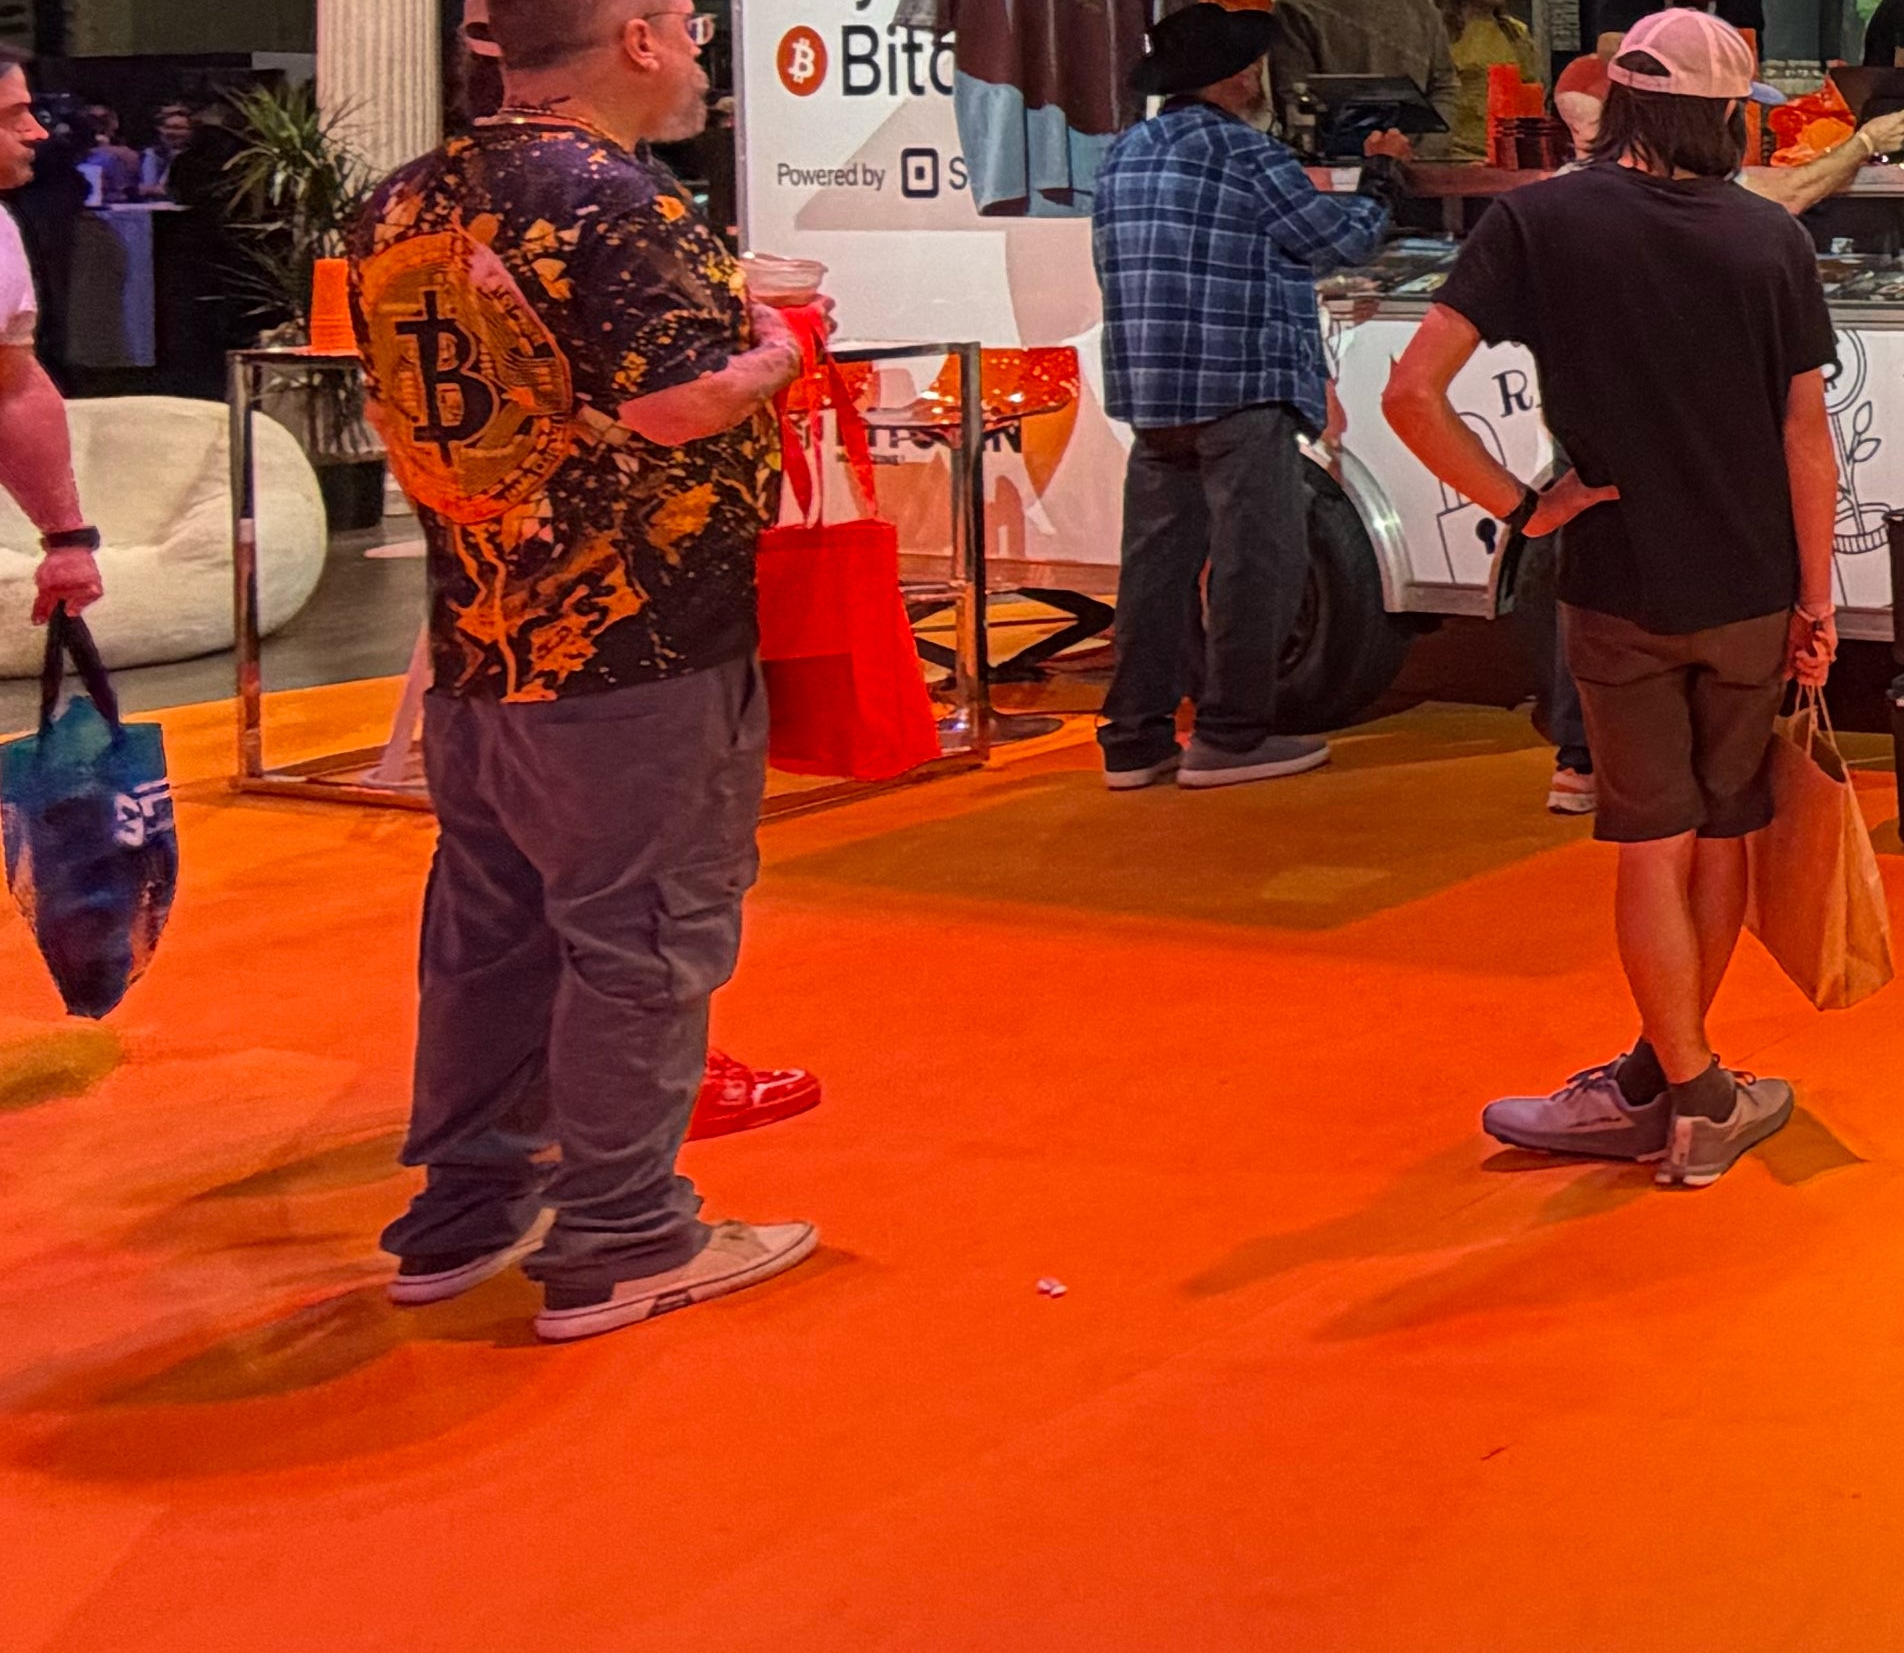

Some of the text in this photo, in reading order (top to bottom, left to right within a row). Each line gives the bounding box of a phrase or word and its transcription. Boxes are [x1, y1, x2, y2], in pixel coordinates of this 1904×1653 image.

[841, 24, 956, 97] Bitc
[777, 162, 886, 191] Powered by
